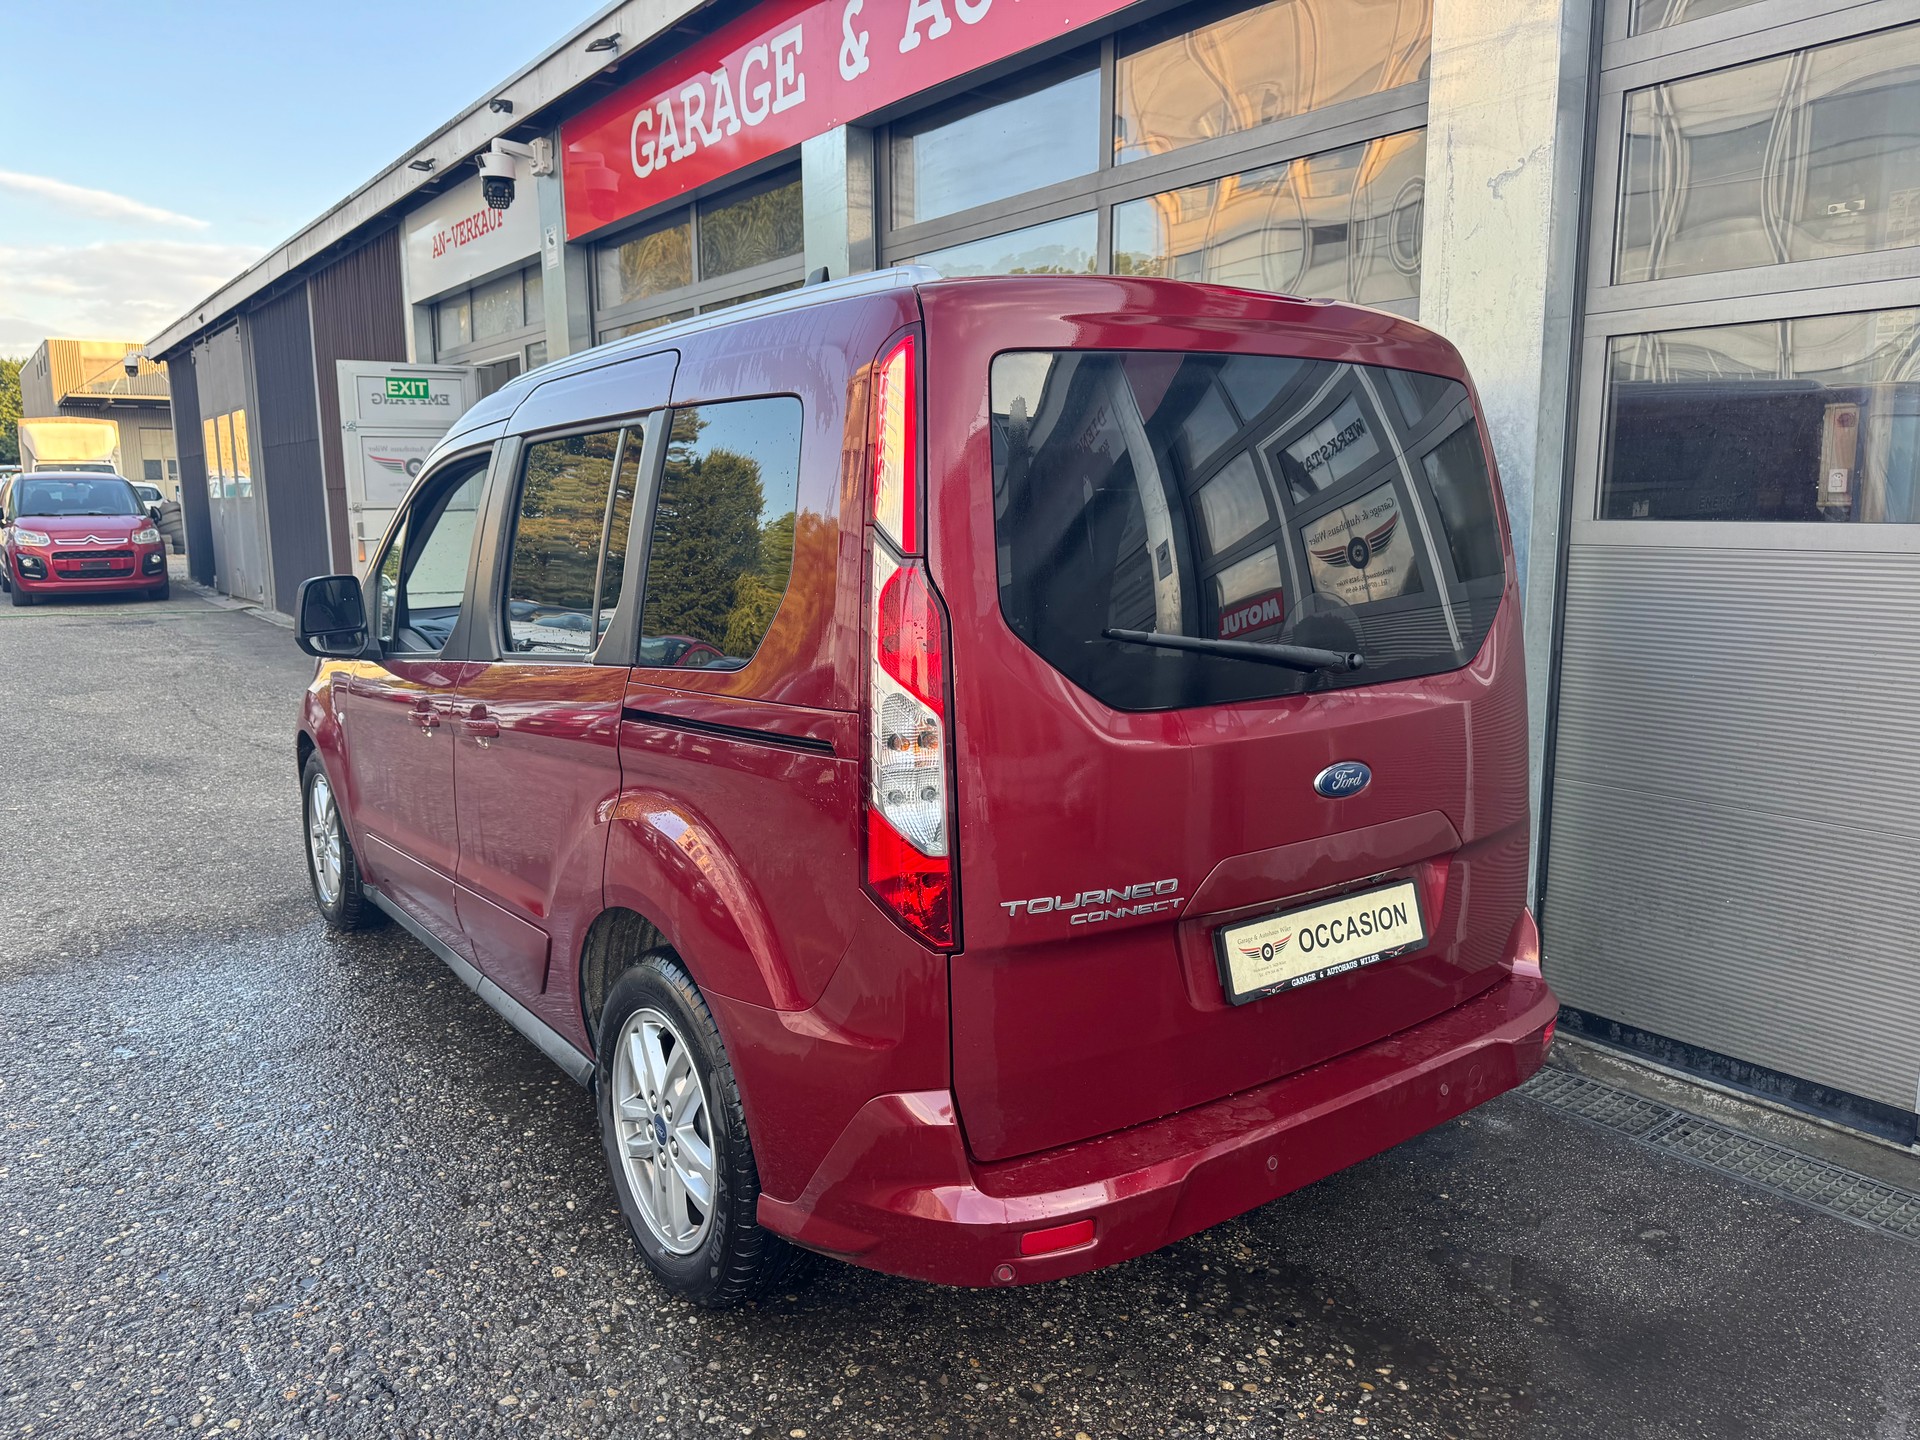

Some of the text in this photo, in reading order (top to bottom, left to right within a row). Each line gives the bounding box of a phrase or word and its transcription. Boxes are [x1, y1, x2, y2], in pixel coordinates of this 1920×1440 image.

[630, 24, 805, 179] GARAGE
[838, 0, 870, 82] &
[387, 380, 427, 396] EXIT
[1331, 768, 1363, 790] Ford
[999, 877, 1180, 918] TOURNEO
[1070, 897, 1185, 926] CONNECT
[1299, 902, 1407, 953] OCCASION
[1291, 973, 1317, 987] GARAGE
[1326, 960, 1358, 977] AUTOHAUS
[1359, 954, 1381, 965] WILER
